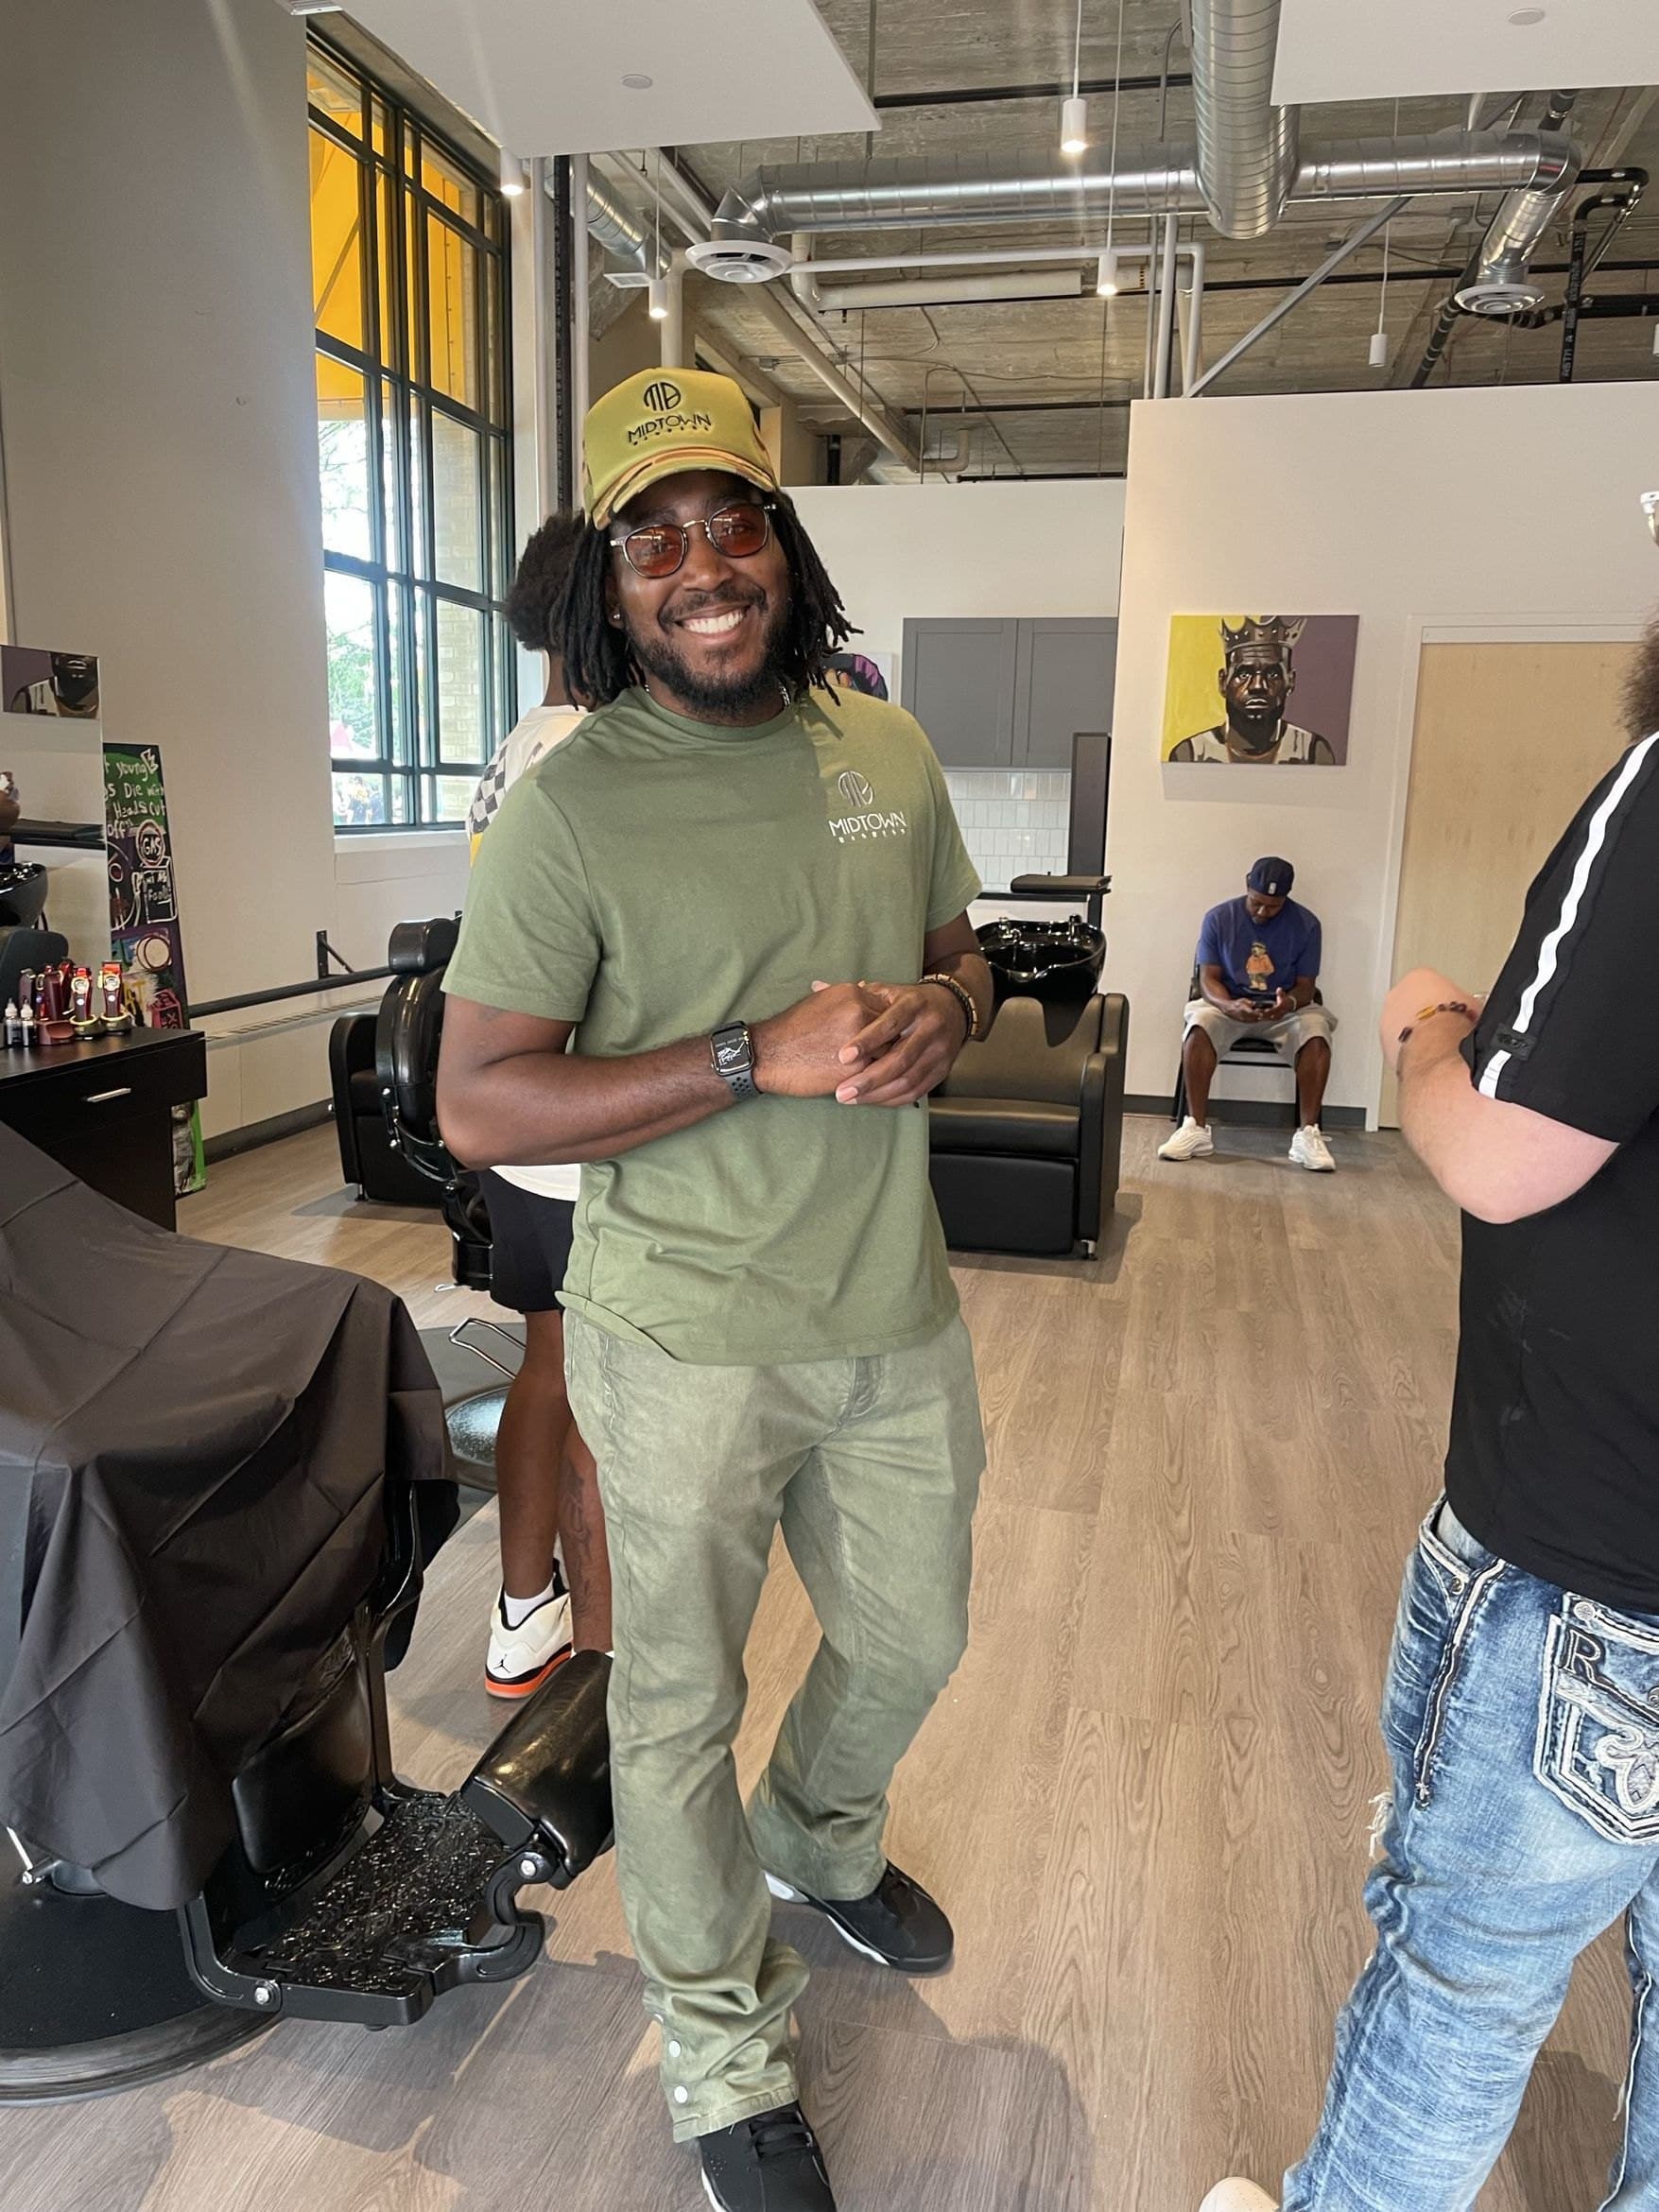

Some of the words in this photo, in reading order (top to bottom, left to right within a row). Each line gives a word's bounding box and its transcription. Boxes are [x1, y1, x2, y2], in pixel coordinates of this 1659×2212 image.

[628, 414, 712, 443] MIDTOWN
[124, 783, 144, 798] Die
[828, 811, 907, 837] MIDTOWN
[143, 837, 161, 856] GAS
